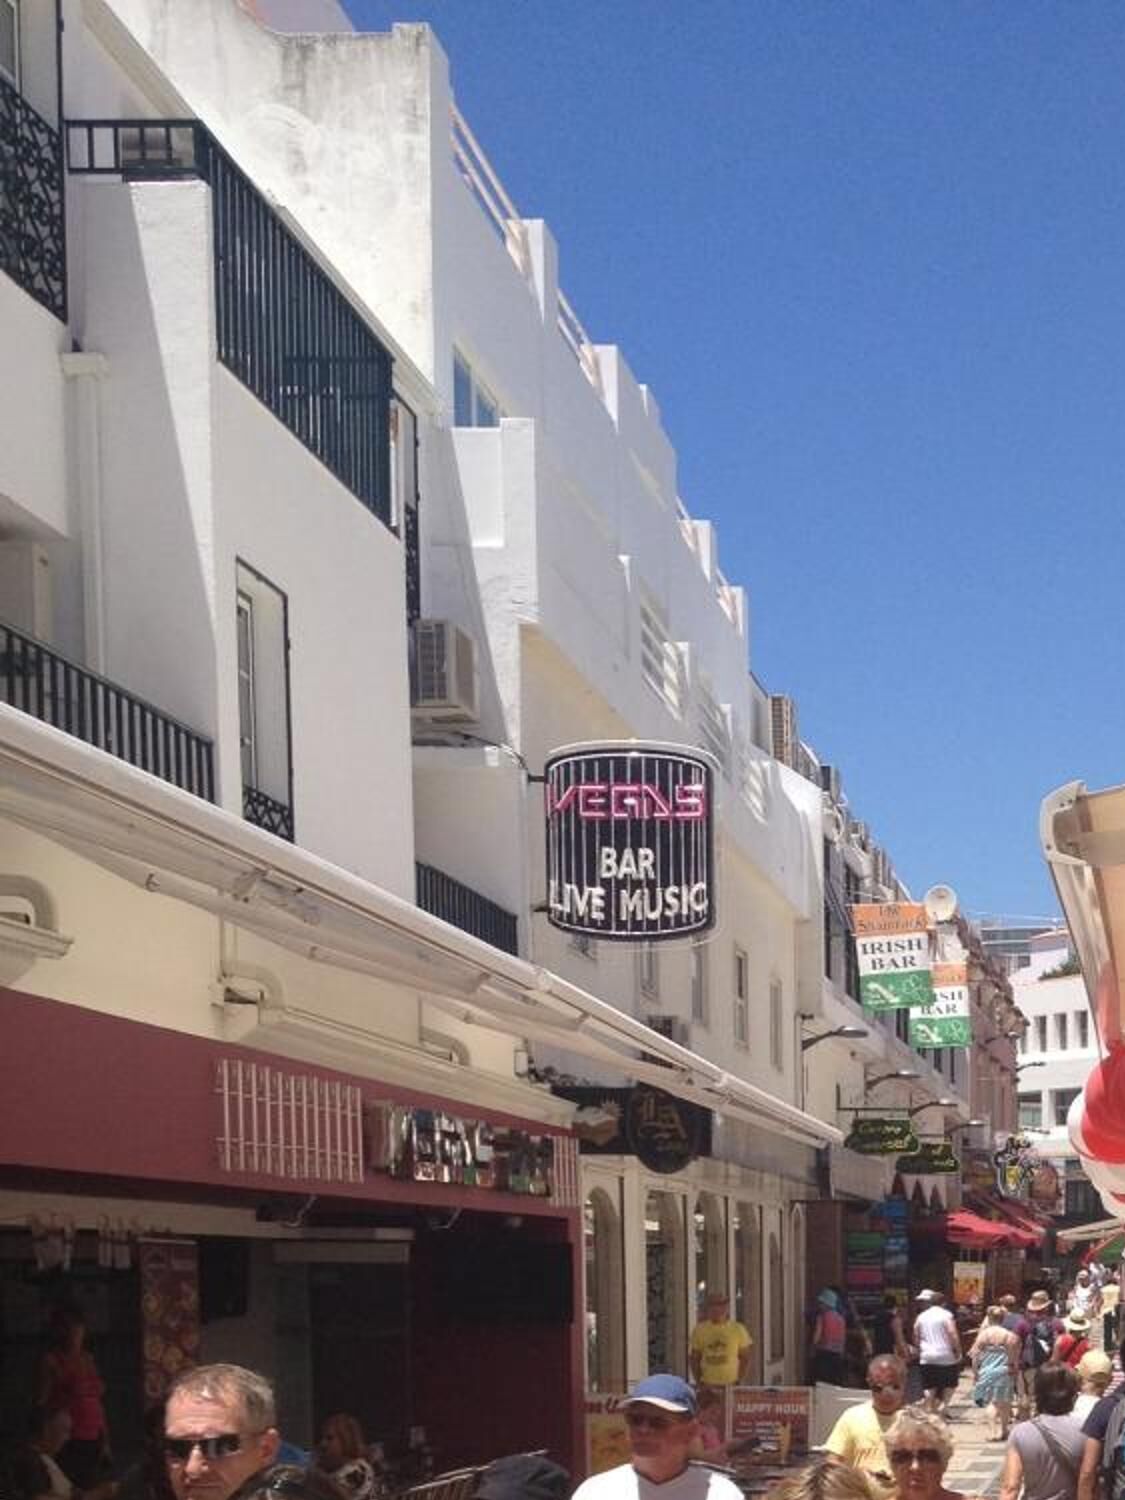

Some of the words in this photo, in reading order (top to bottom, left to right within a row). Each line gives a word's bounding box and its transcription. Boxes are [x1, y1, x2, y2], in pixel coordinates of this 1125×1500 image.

[546, 784, 704, 820] VEGAS
[600, 847, 655, 880] BAR
[550, 880, 605, 920] LIVE
[620, 882, 709, 921] MUSIC
[861, 938, 922, 955] IRISH
[871, 956, 917, 971] BAR
[921, 1003, 958, 1015] BAR
